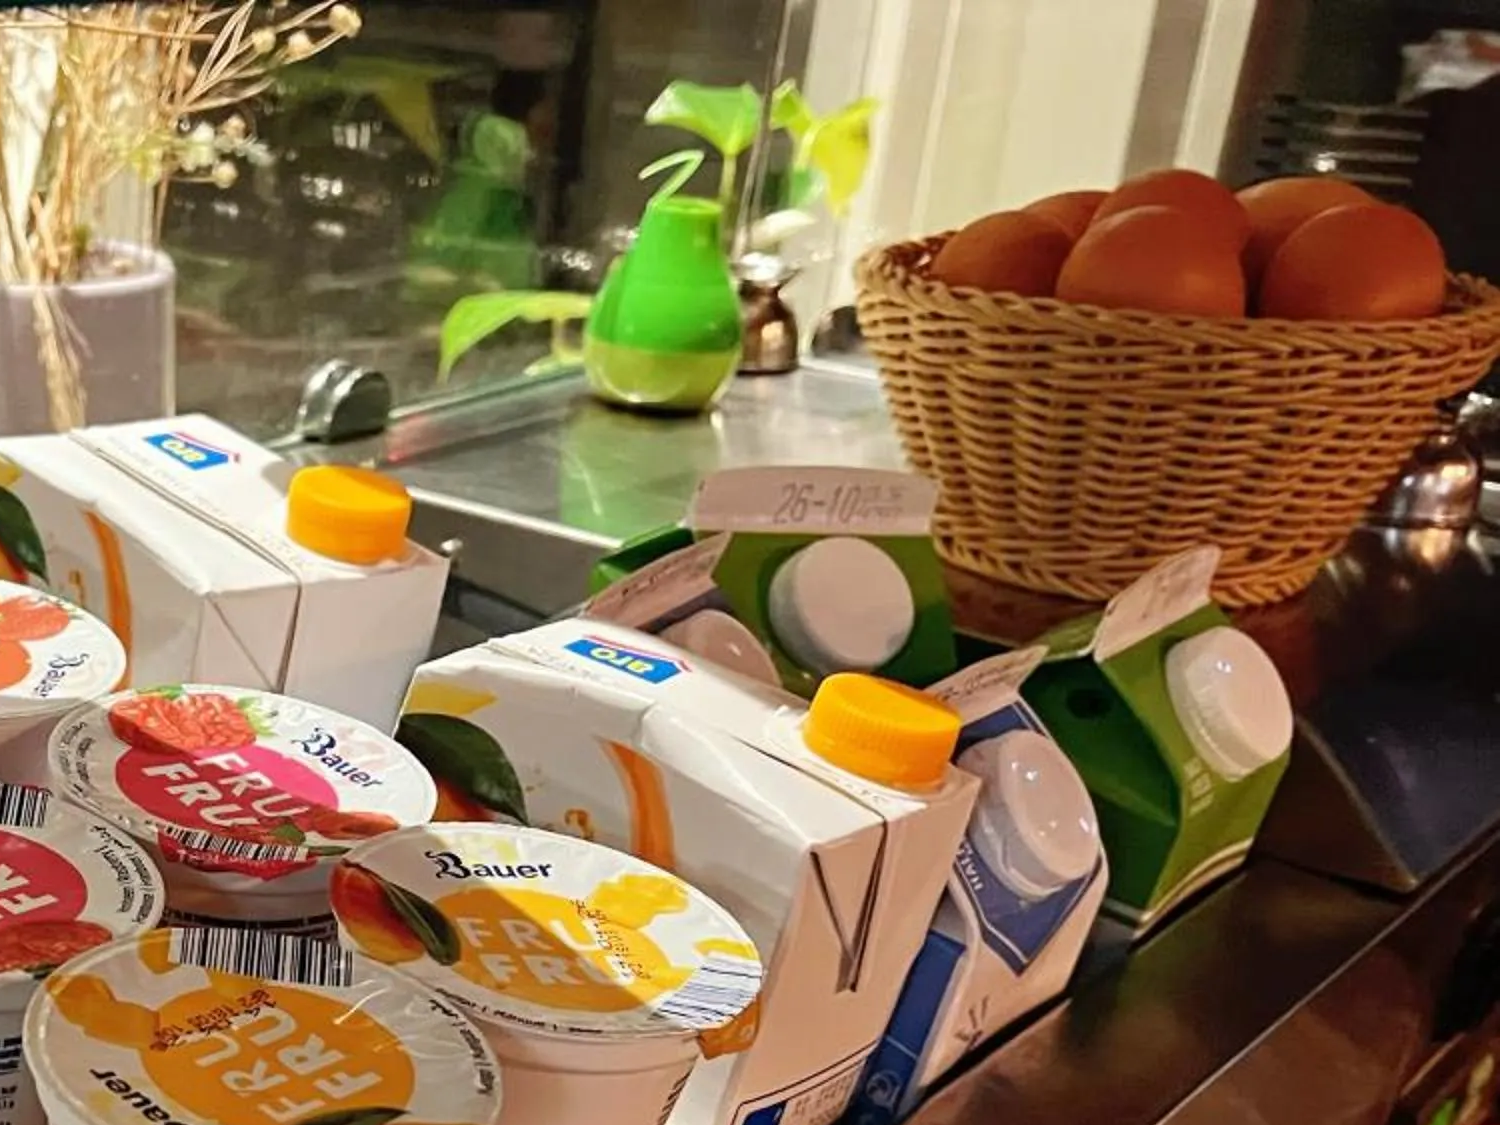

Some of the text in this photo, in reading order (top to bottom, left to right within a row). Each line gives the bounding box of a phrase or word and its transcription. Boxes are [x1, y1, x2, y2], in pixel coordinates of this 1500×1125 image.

[196, 753, 310, 819] FRU
[291, 725, 385, 791] Bauer
[141, 762, 260, 829] FRU
[426, 850, 555, 881] Bauer
[455, 916, 612, 953] FRU
[478, 952, 636, 989] FRU
[174, 1031, 327, 1124] FRU
[231, 1005, 384, 1098] FRU
